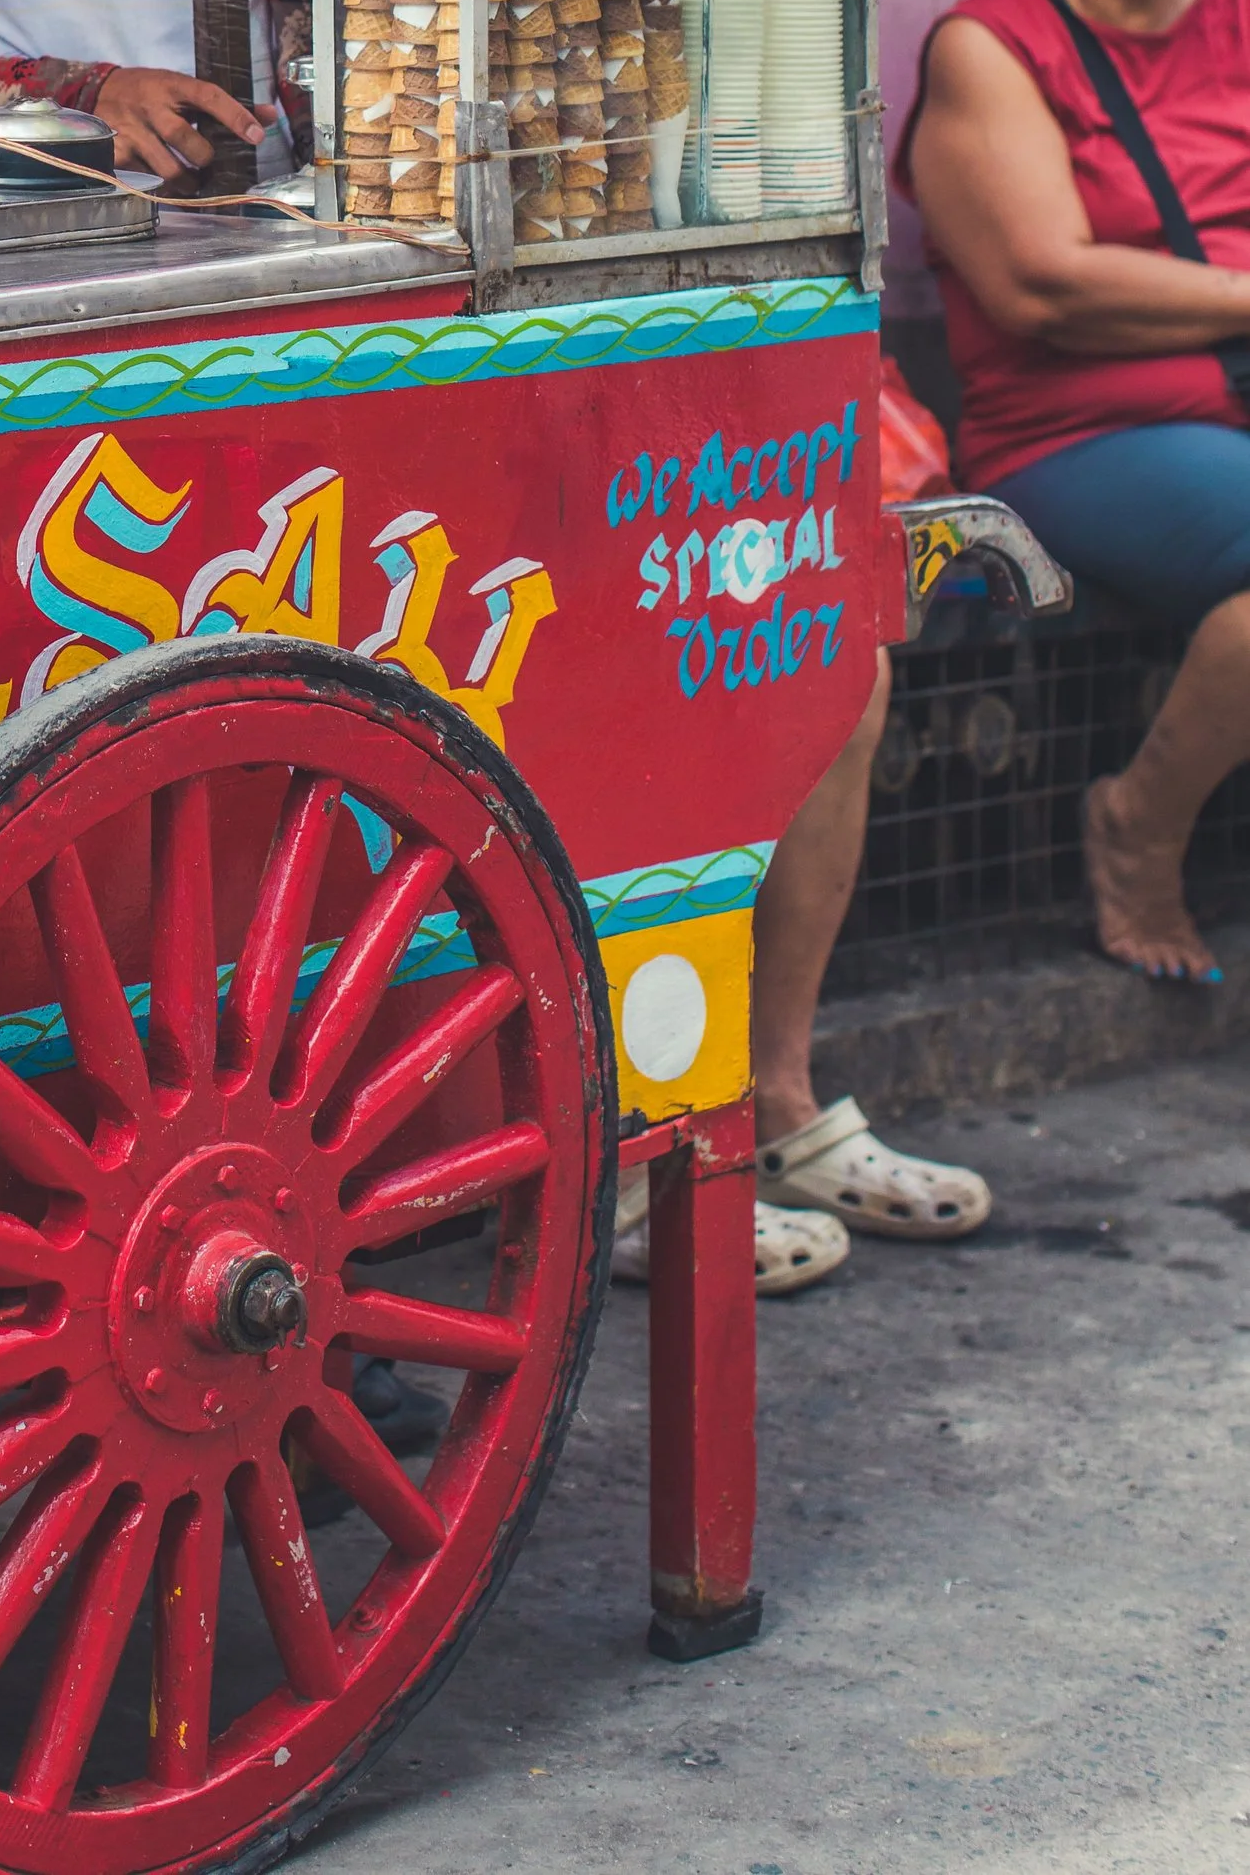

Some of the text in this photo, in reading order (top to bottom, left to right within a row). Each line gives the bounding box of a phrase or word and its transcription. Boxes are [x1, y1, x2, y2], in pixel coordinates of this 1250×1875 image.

[687, 399, 862, 517] Accept
[636, 504, 845, 611] SPECIAL
[665, 591, 845, 700] Order
